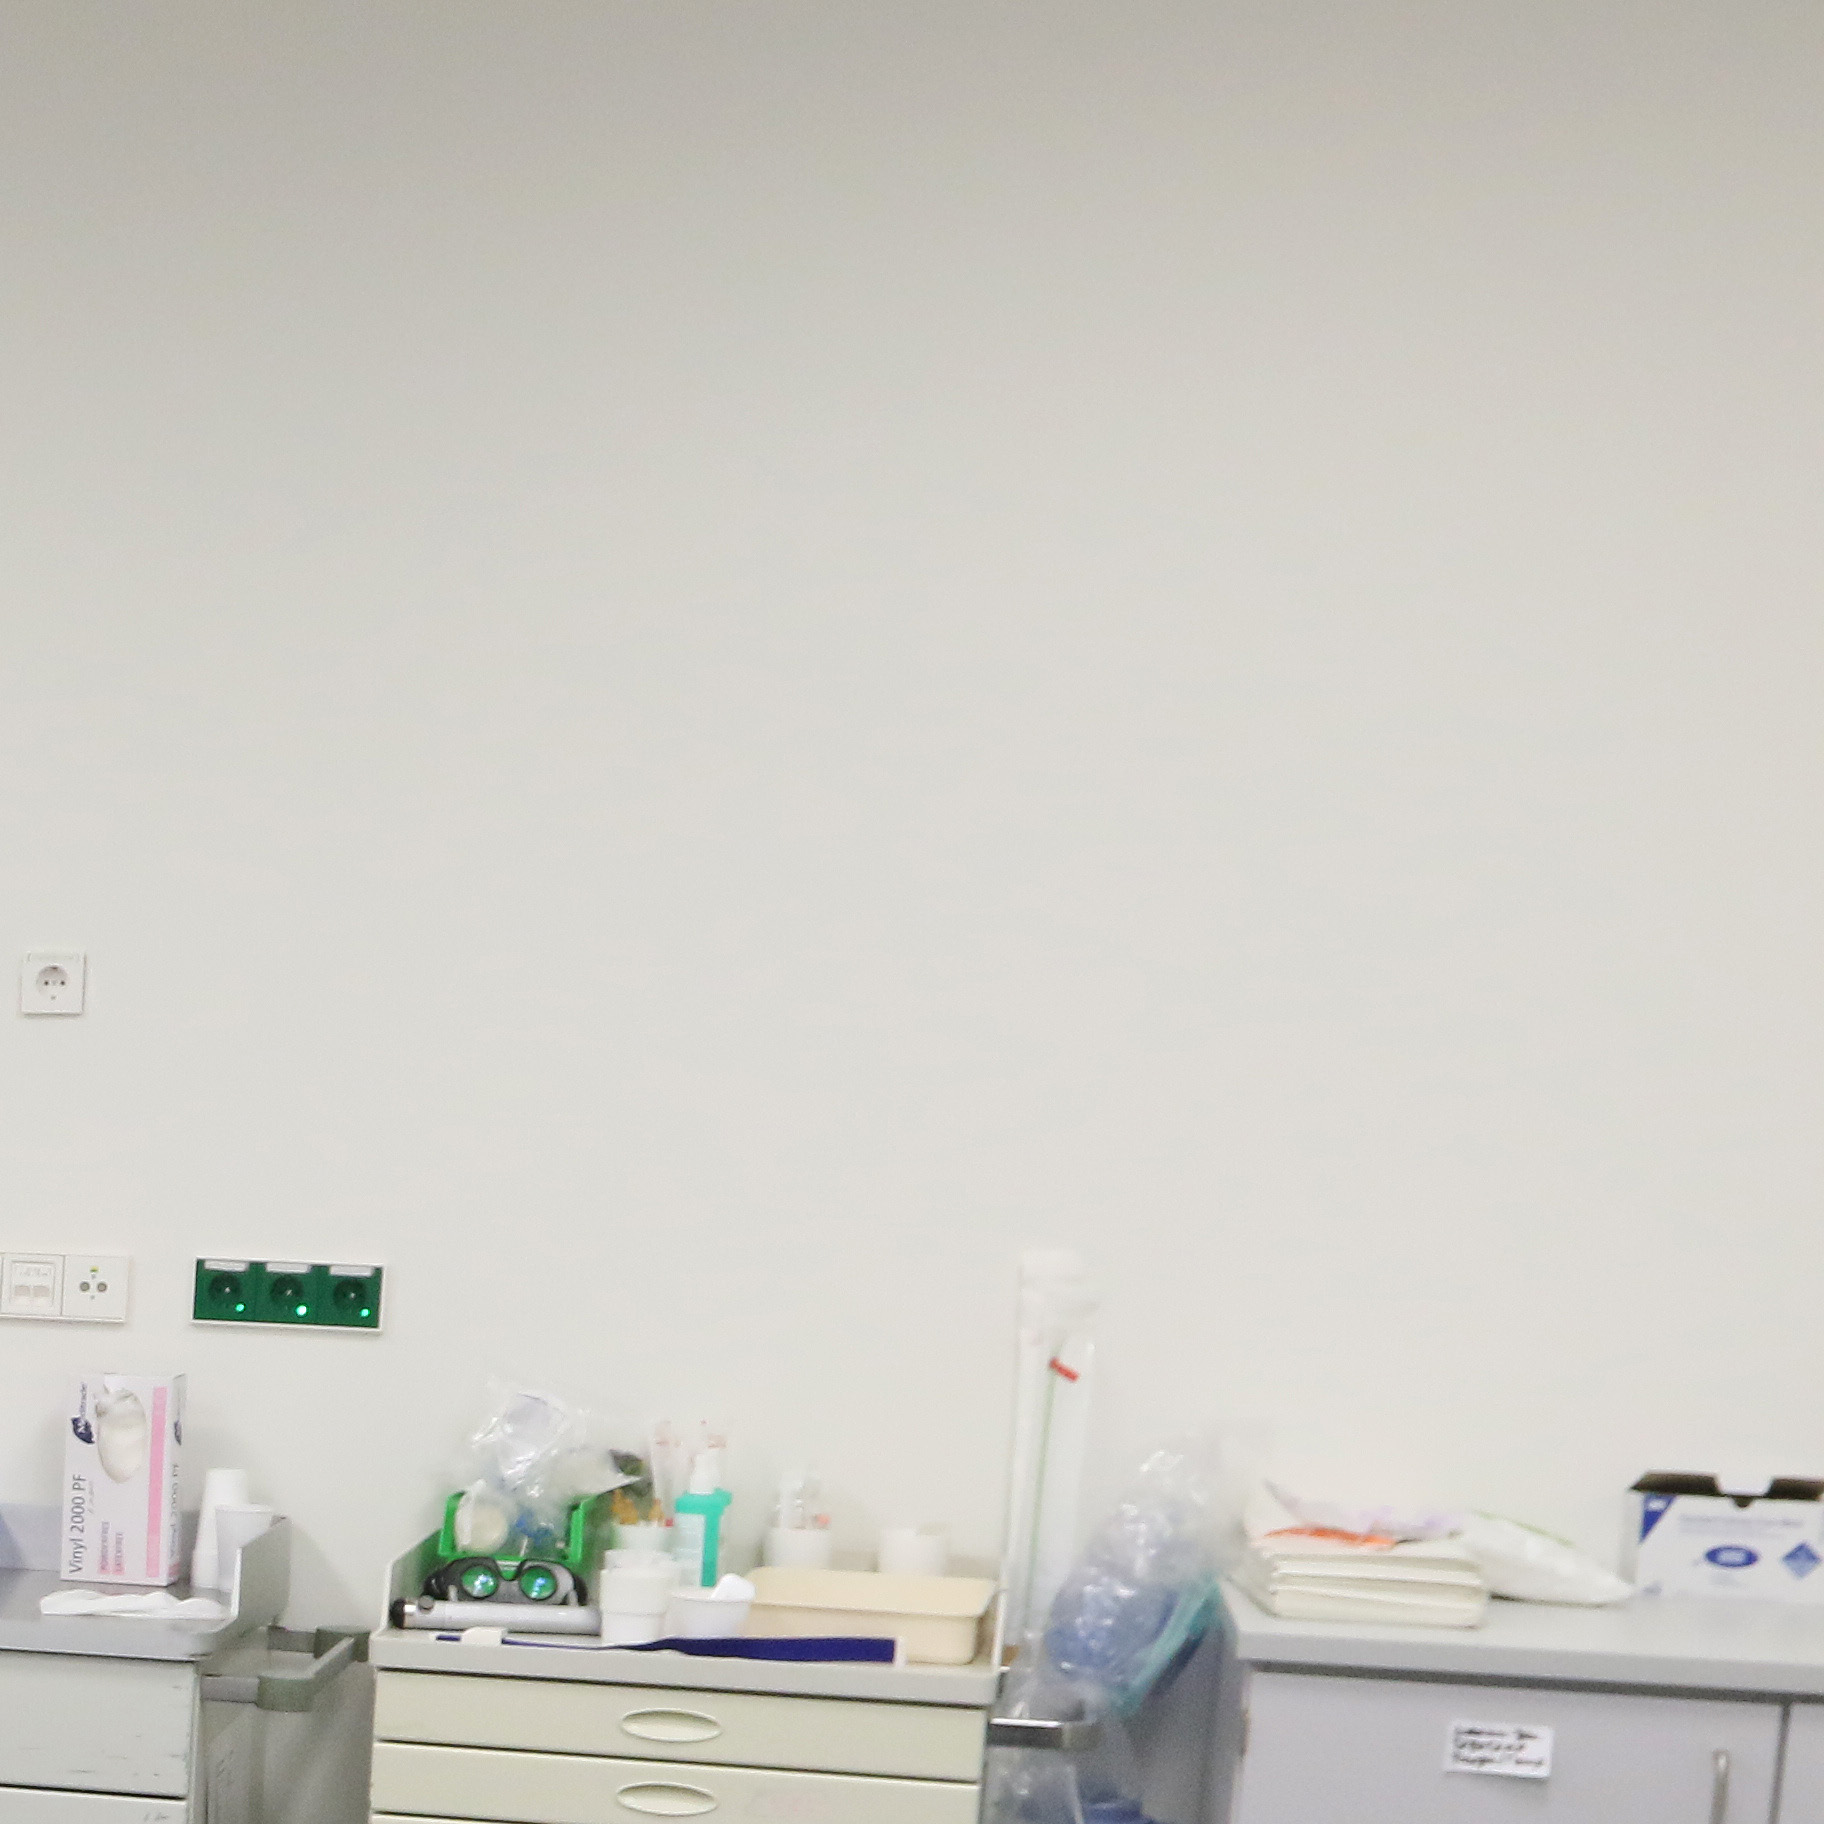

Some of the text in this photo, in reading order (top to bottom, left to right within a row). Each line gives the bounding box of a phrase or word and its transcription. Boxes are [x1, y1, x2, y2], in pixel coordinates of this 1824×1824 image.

[69, 1474, 88, 1574] Vinyl 2000 PF
